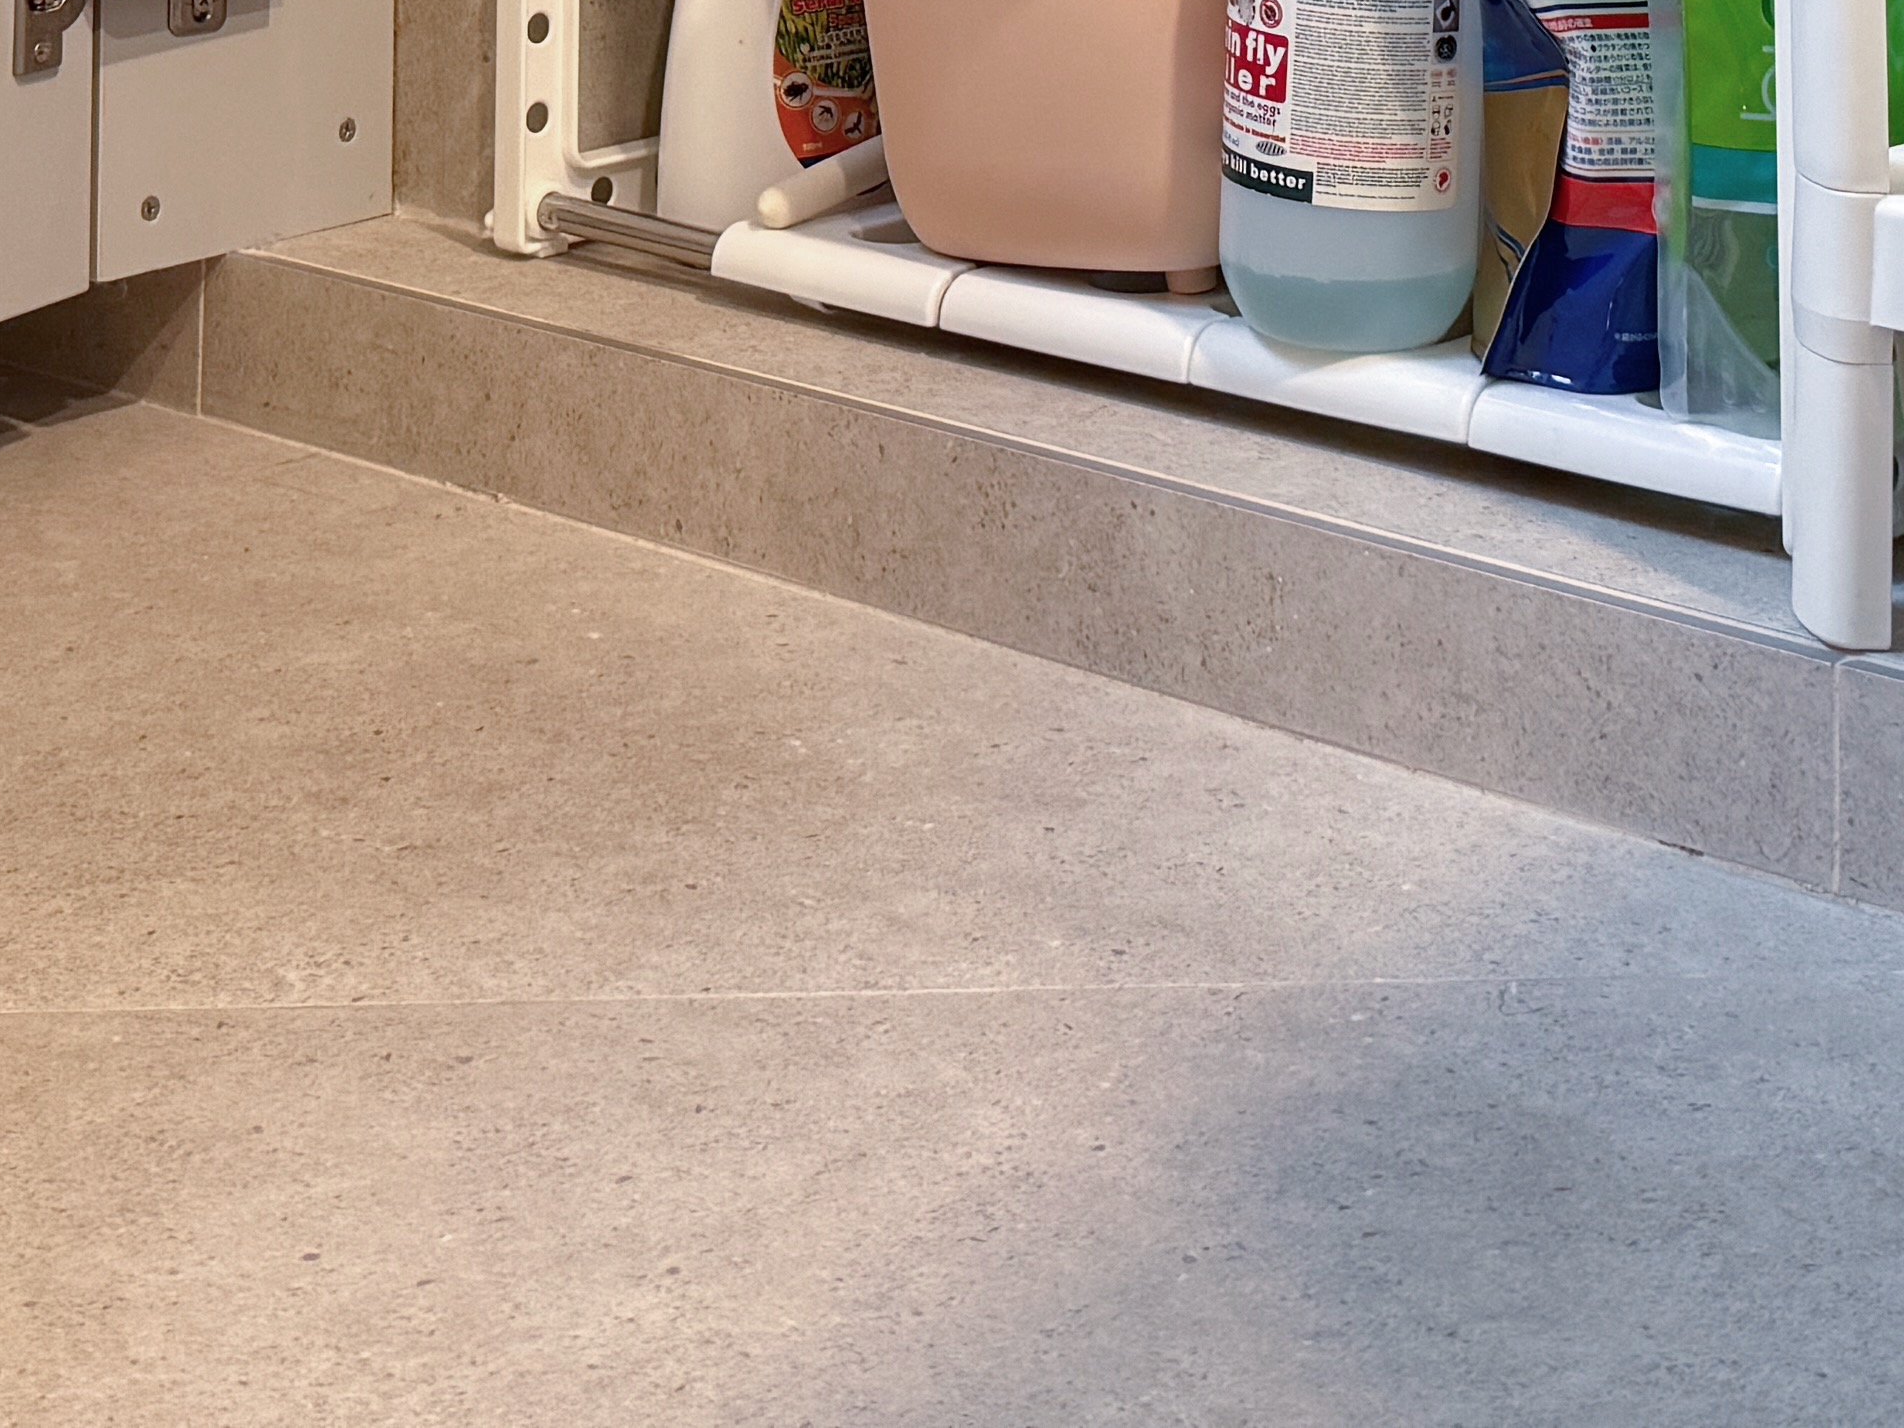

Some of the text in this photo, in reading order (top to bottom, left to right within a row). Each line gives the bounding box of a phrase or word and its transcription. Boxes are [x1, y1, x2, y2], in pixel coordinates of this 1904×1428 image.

[1246, 30, 1286, 76] fly
[1230, 154, 1247, 175] kill
[1250, 162, 1306, 190] better
